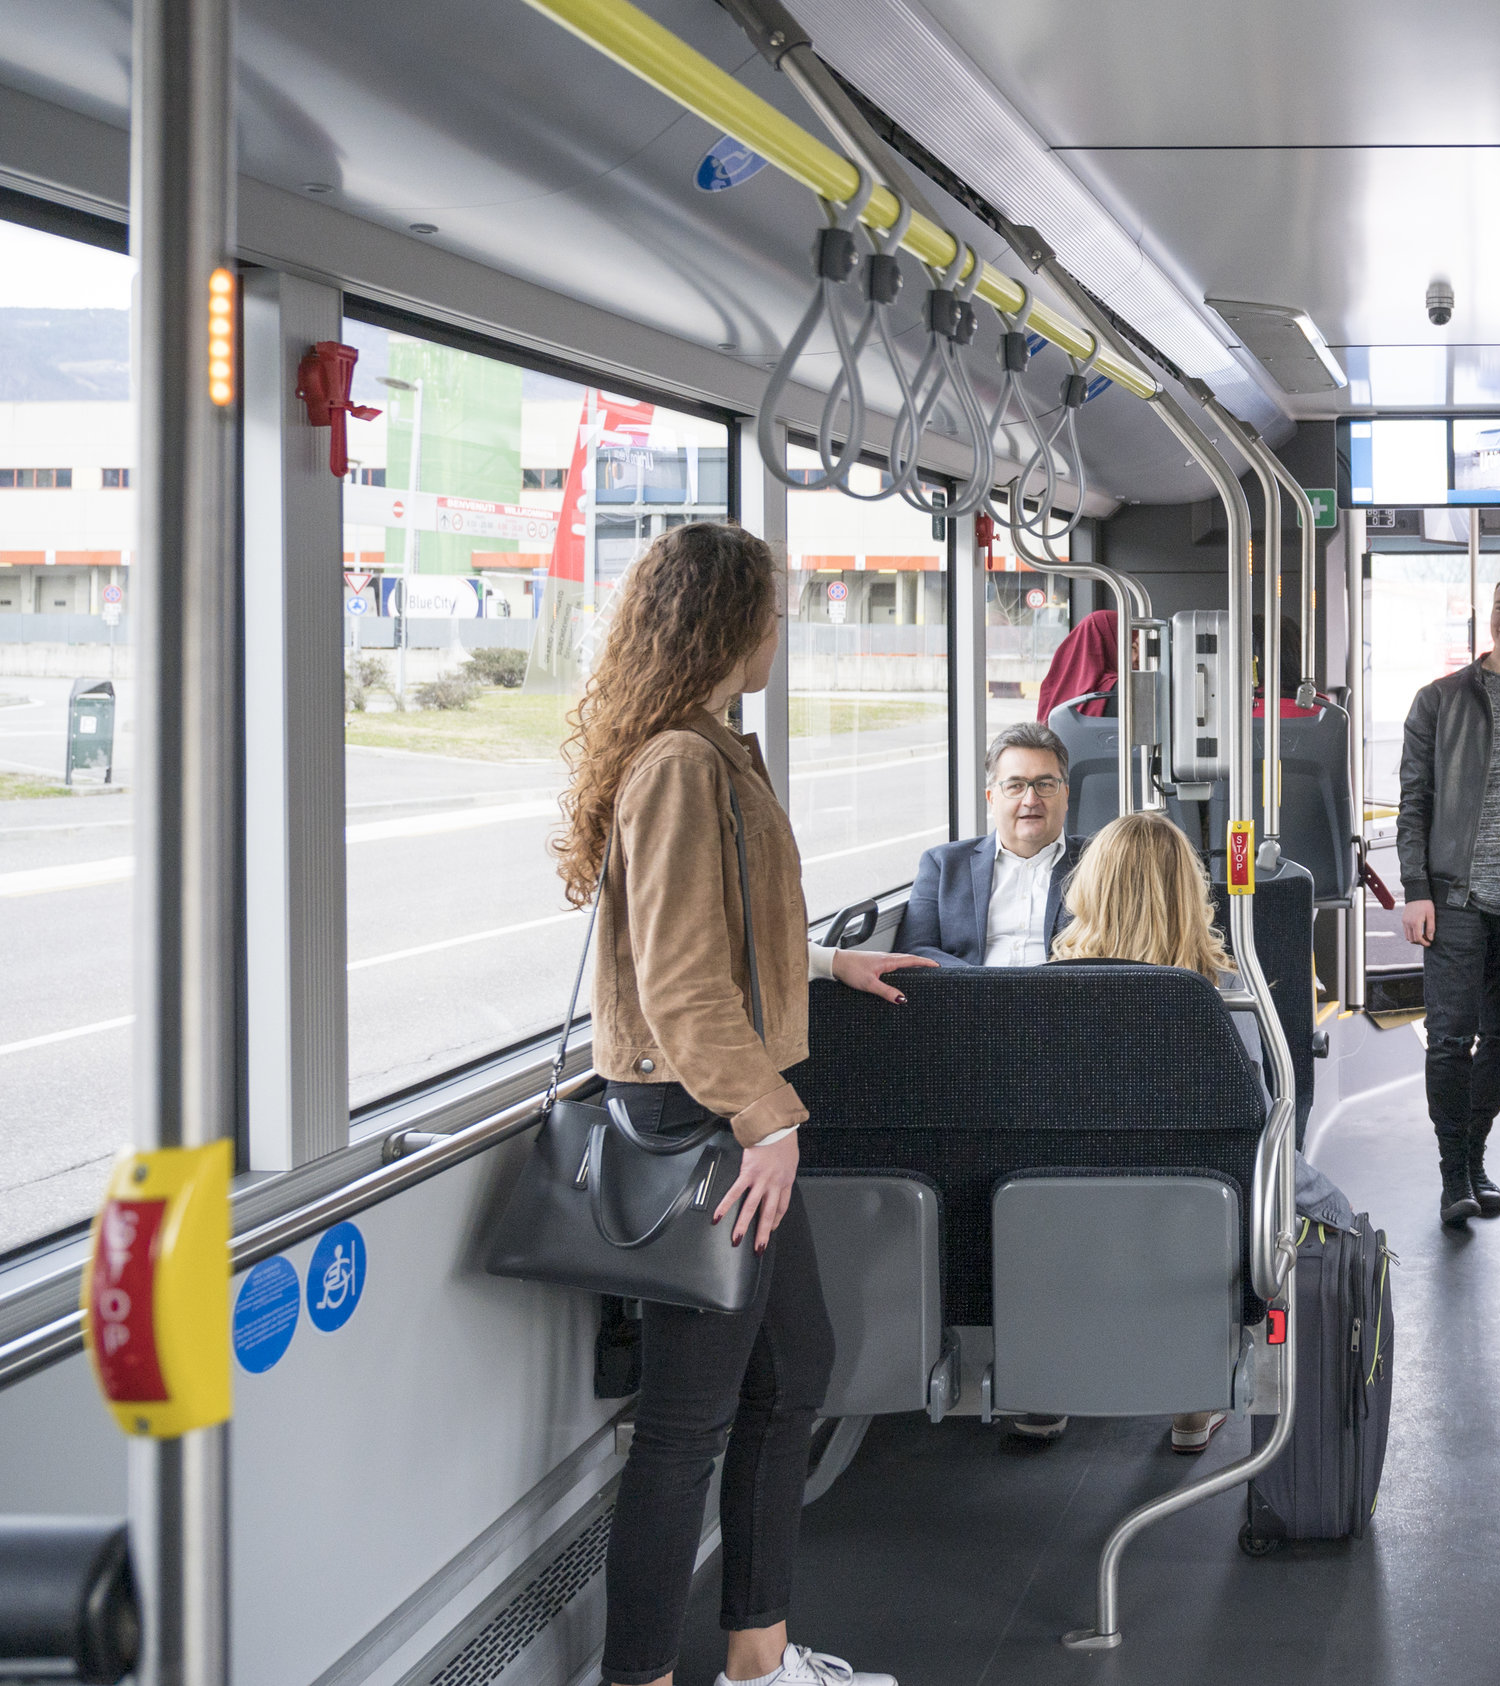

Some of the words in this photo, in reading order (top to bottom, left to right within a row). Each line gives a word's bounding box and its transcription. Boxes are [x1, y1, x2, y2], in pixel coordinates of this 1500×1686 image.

[447, 498, 496, 513] BENVENUTI
[409, 595, 432, 609] Blue
[434, 595, 457, 615] City
[1235, 835, 1243, 871] STOP
